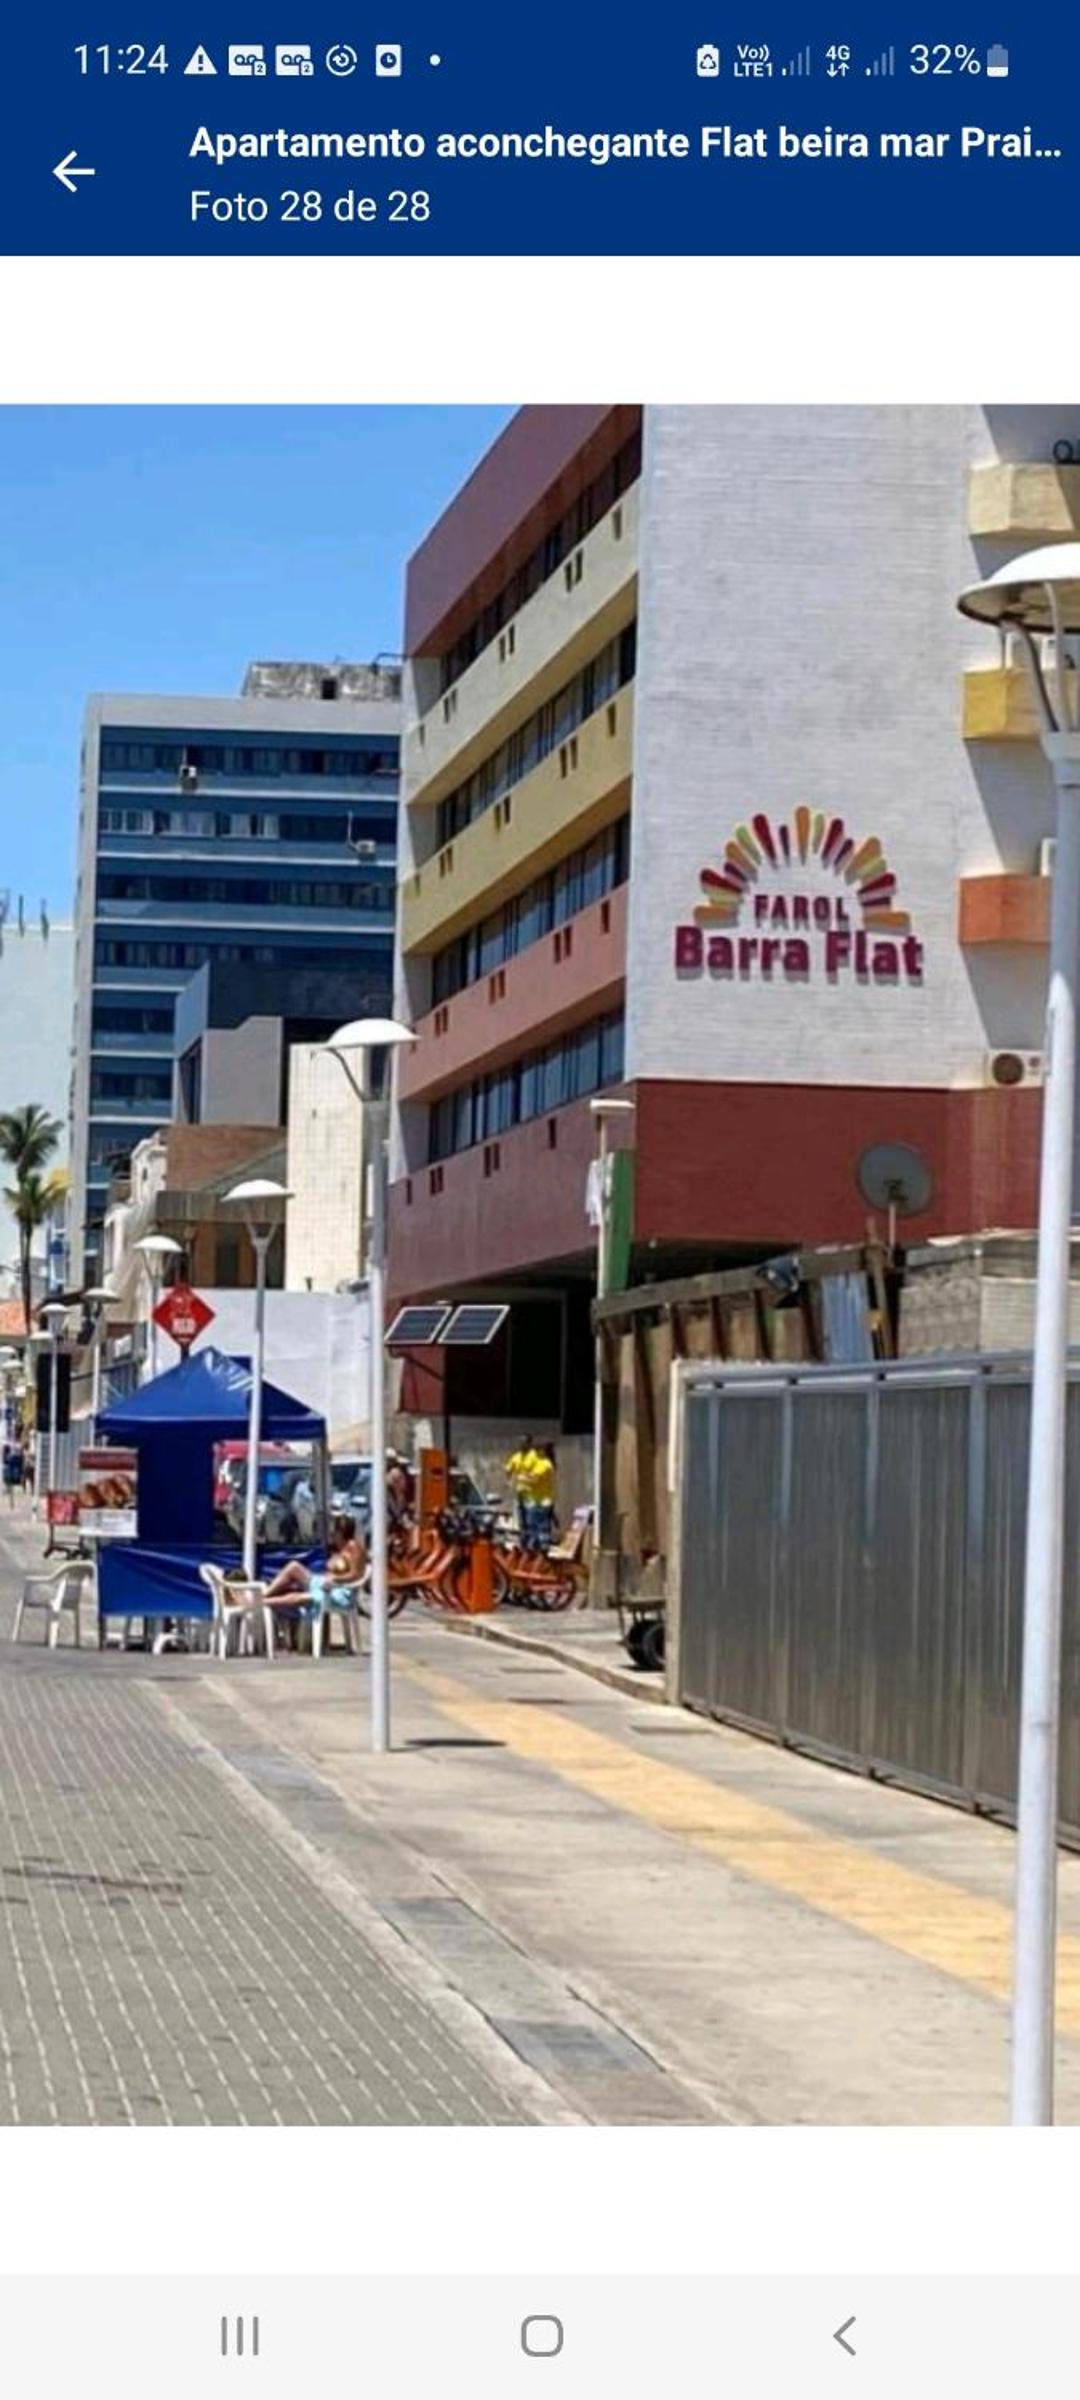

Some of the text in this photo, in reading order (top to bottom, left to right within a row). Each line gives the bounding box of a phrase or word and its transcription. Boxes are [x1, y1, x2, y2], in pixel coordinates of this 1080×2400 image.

[753, 894, 849, 925] FAROL
[675, 924, 925, 980] Barra Flat
